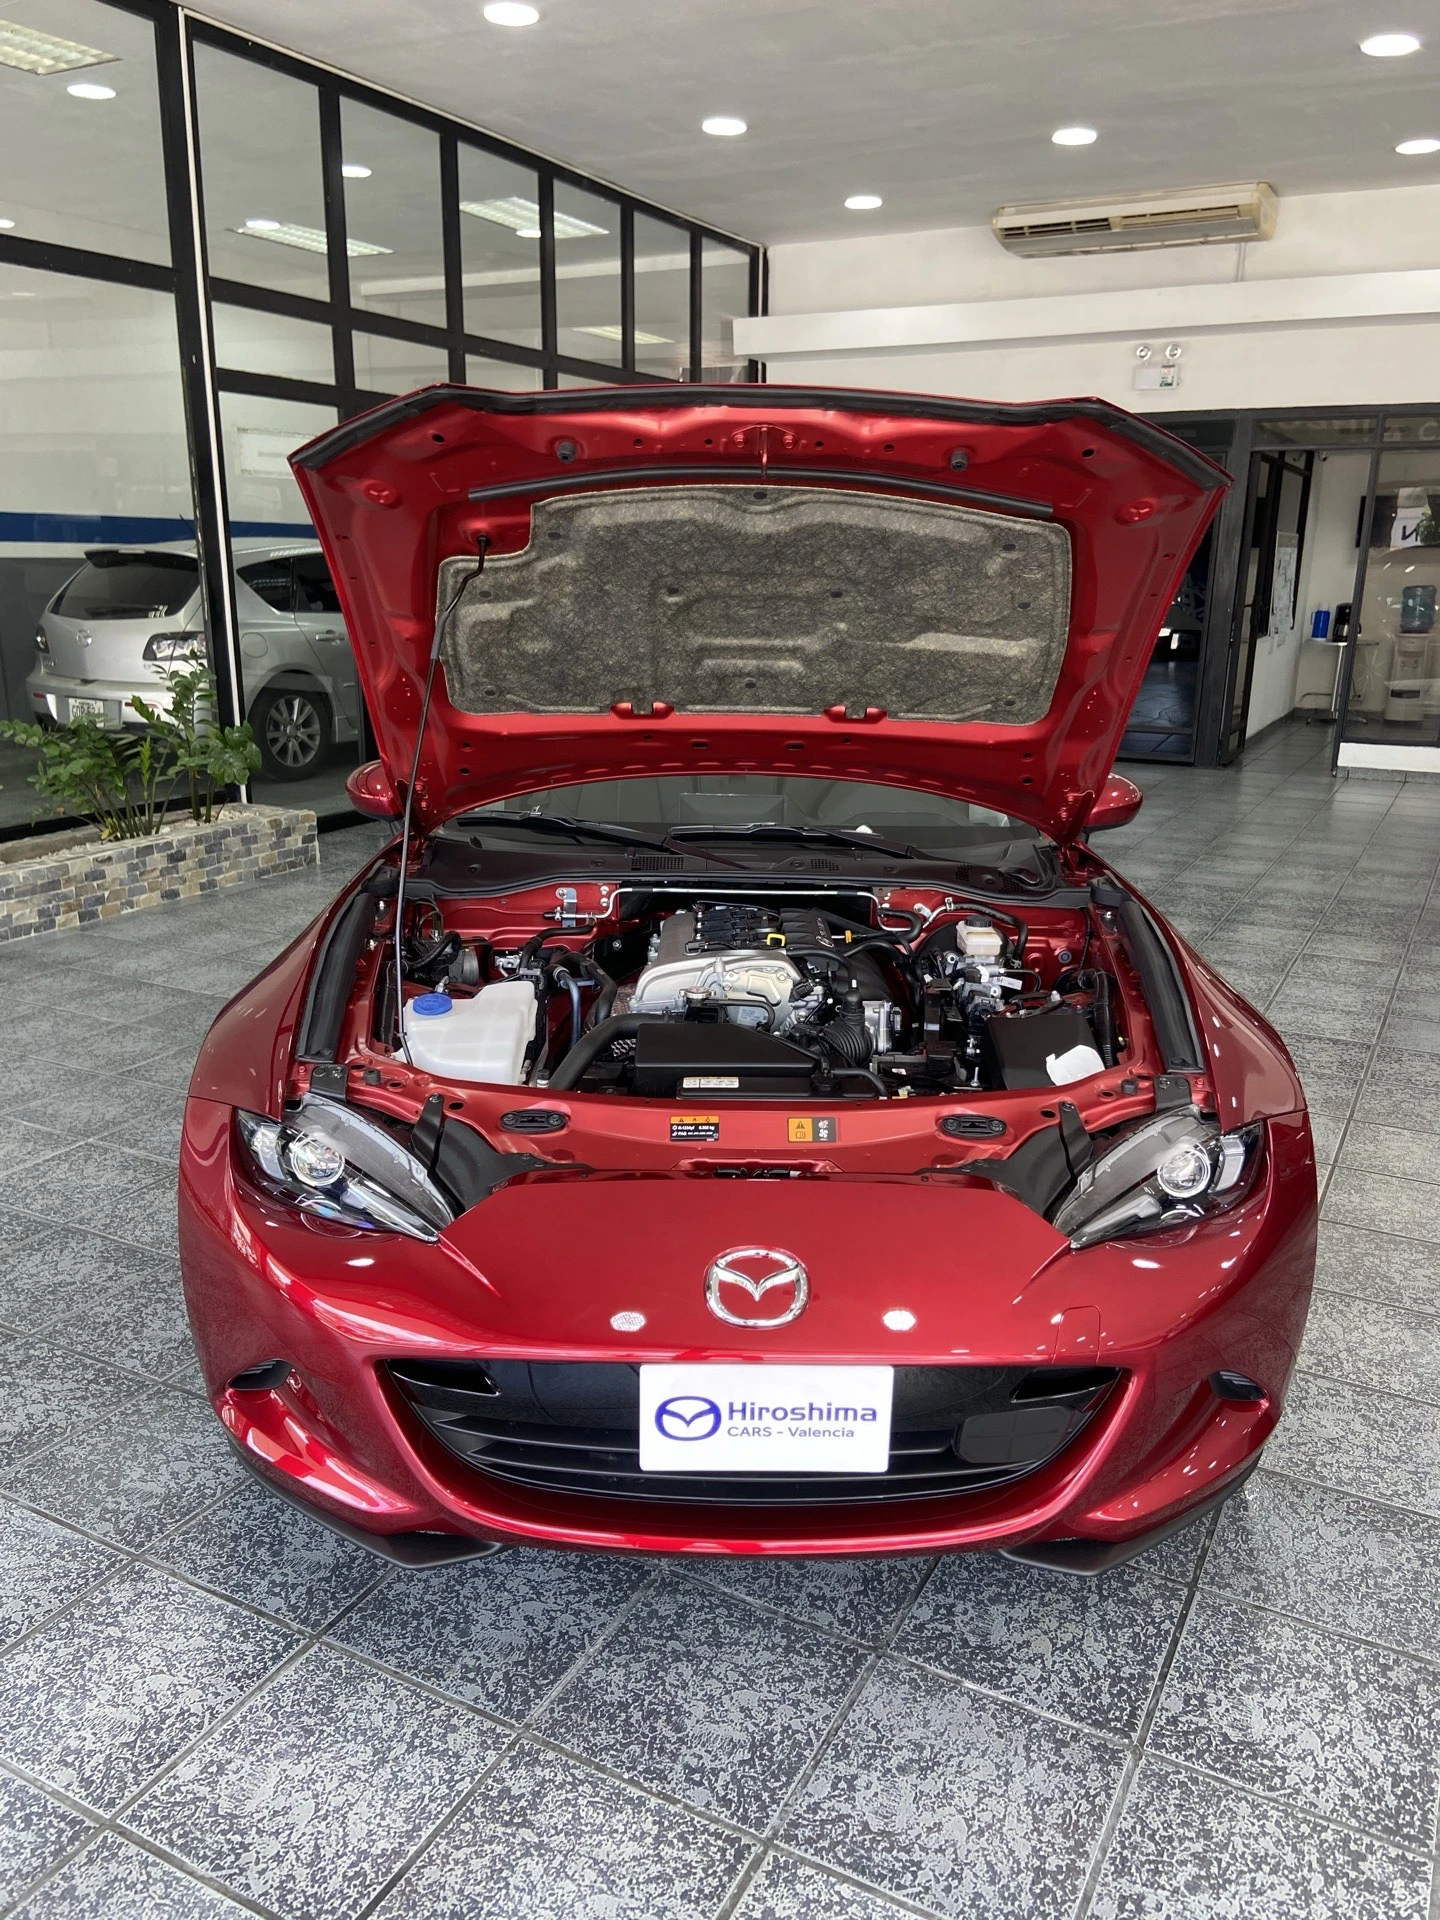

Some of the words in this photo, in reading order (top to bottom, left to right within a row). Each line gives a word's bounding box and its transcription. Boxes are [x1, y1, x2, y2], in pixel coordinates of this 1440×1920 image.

[728, 1402, 877, 1422] Hiroshima
[727, 1426, 772, 1437] CARS
[788, 1426, 855, 1438] Valencia
